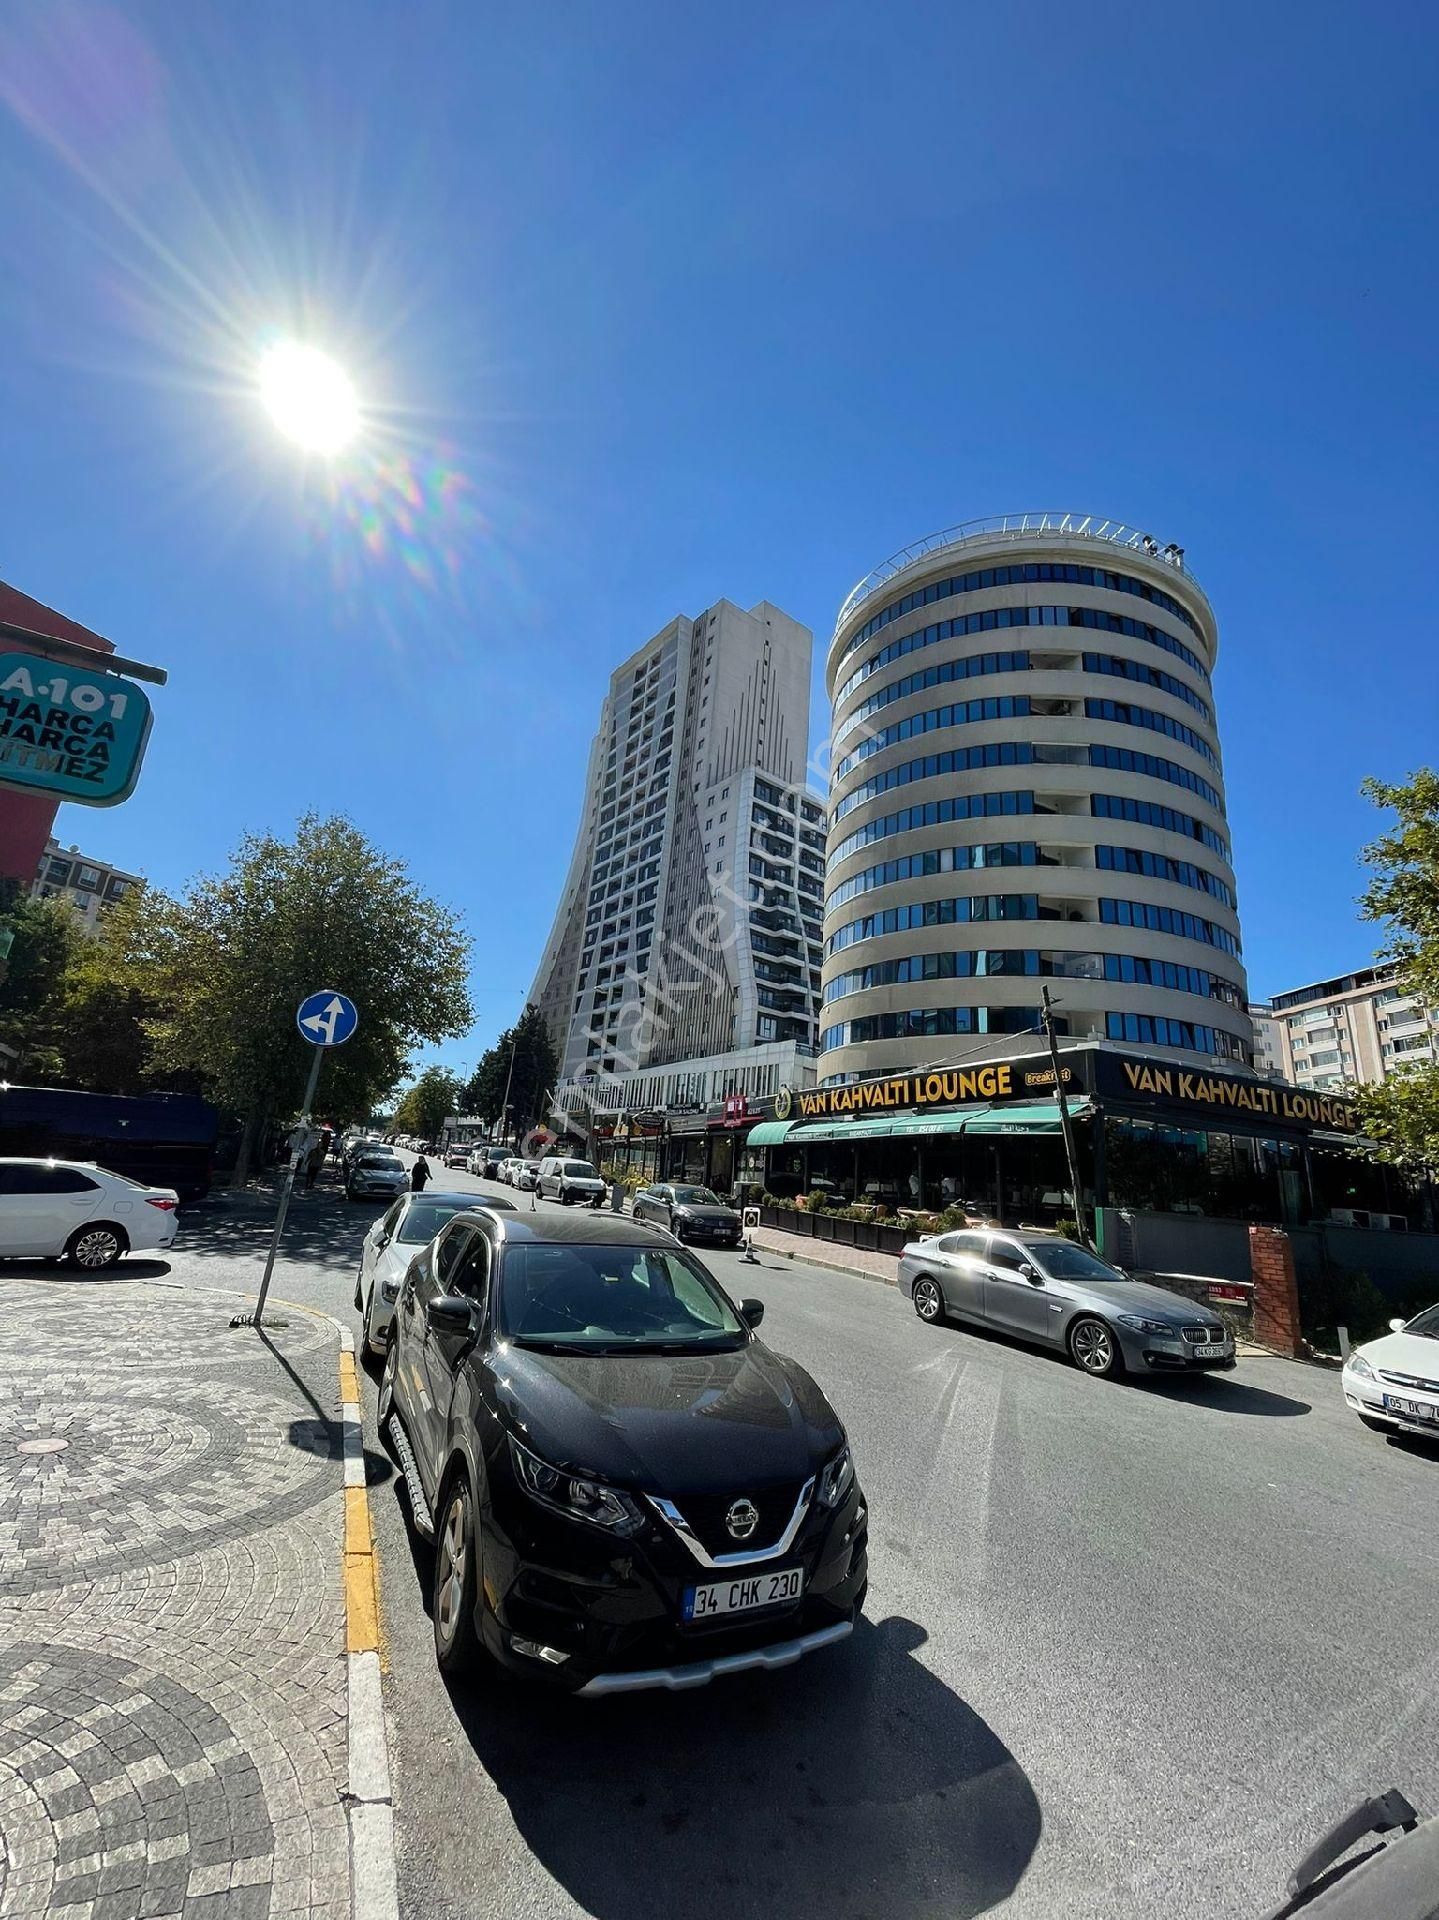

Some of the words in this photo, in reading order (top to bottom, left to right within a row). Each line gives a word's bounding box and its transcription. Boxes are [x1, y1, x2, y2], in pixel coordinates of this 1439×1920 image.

[800, 1094, 826, 1115] VAN
[830, 1080, 909, 1111] KAHVALTI
[915, 1066, 1012, 1102] LOUNGE
[1123, 1062, 1173, 1095] VAN
[1178, 1072, 1278, 1114] KAHVALTI
[1283, 1092, 1356, 1129] LOUNGE
[1390, 1397, 1402, 1409] 05
[1408, 1401, 1420, 1415] DK
[695, 1588, 717, 1613] 34
[728, 1579, 761, 1608] CHK
[768, 1572, 799, 1600] 230
